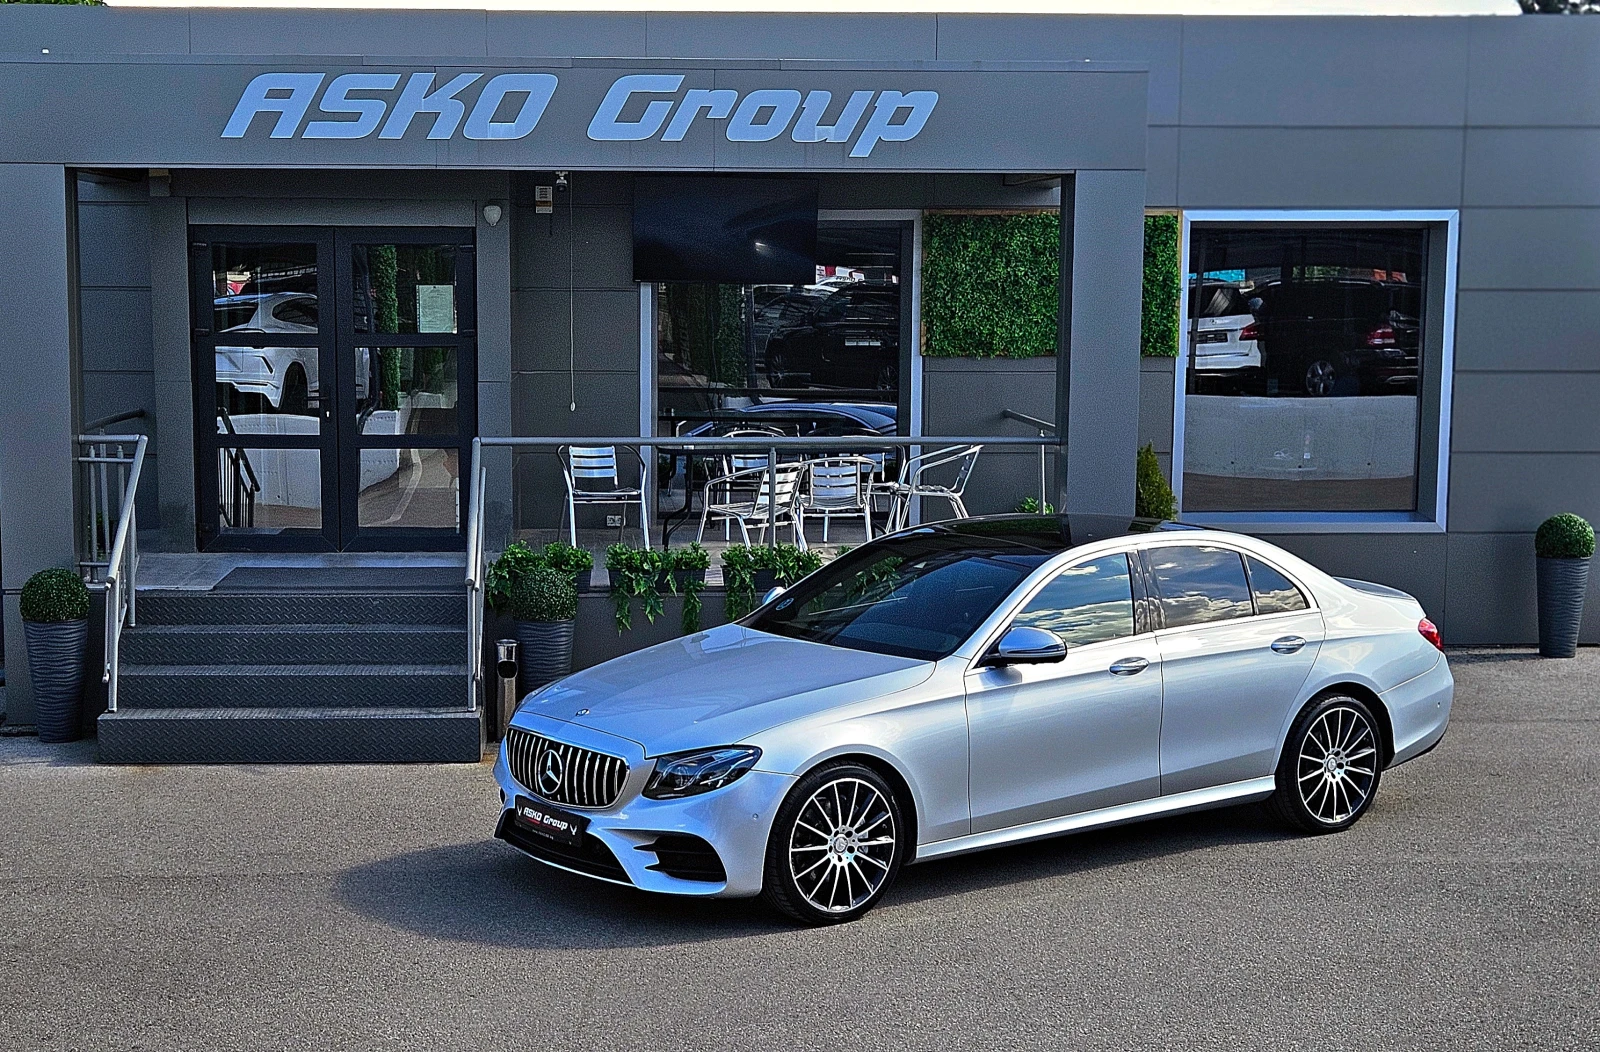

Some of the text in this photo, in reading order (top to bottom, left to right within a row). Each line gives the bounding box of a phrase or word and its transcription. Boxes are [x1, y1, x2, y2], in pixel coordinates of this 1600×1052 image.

[220, 72, 939, 157] ASKO Group
[523, 807, 568, 831] ASKO Group
